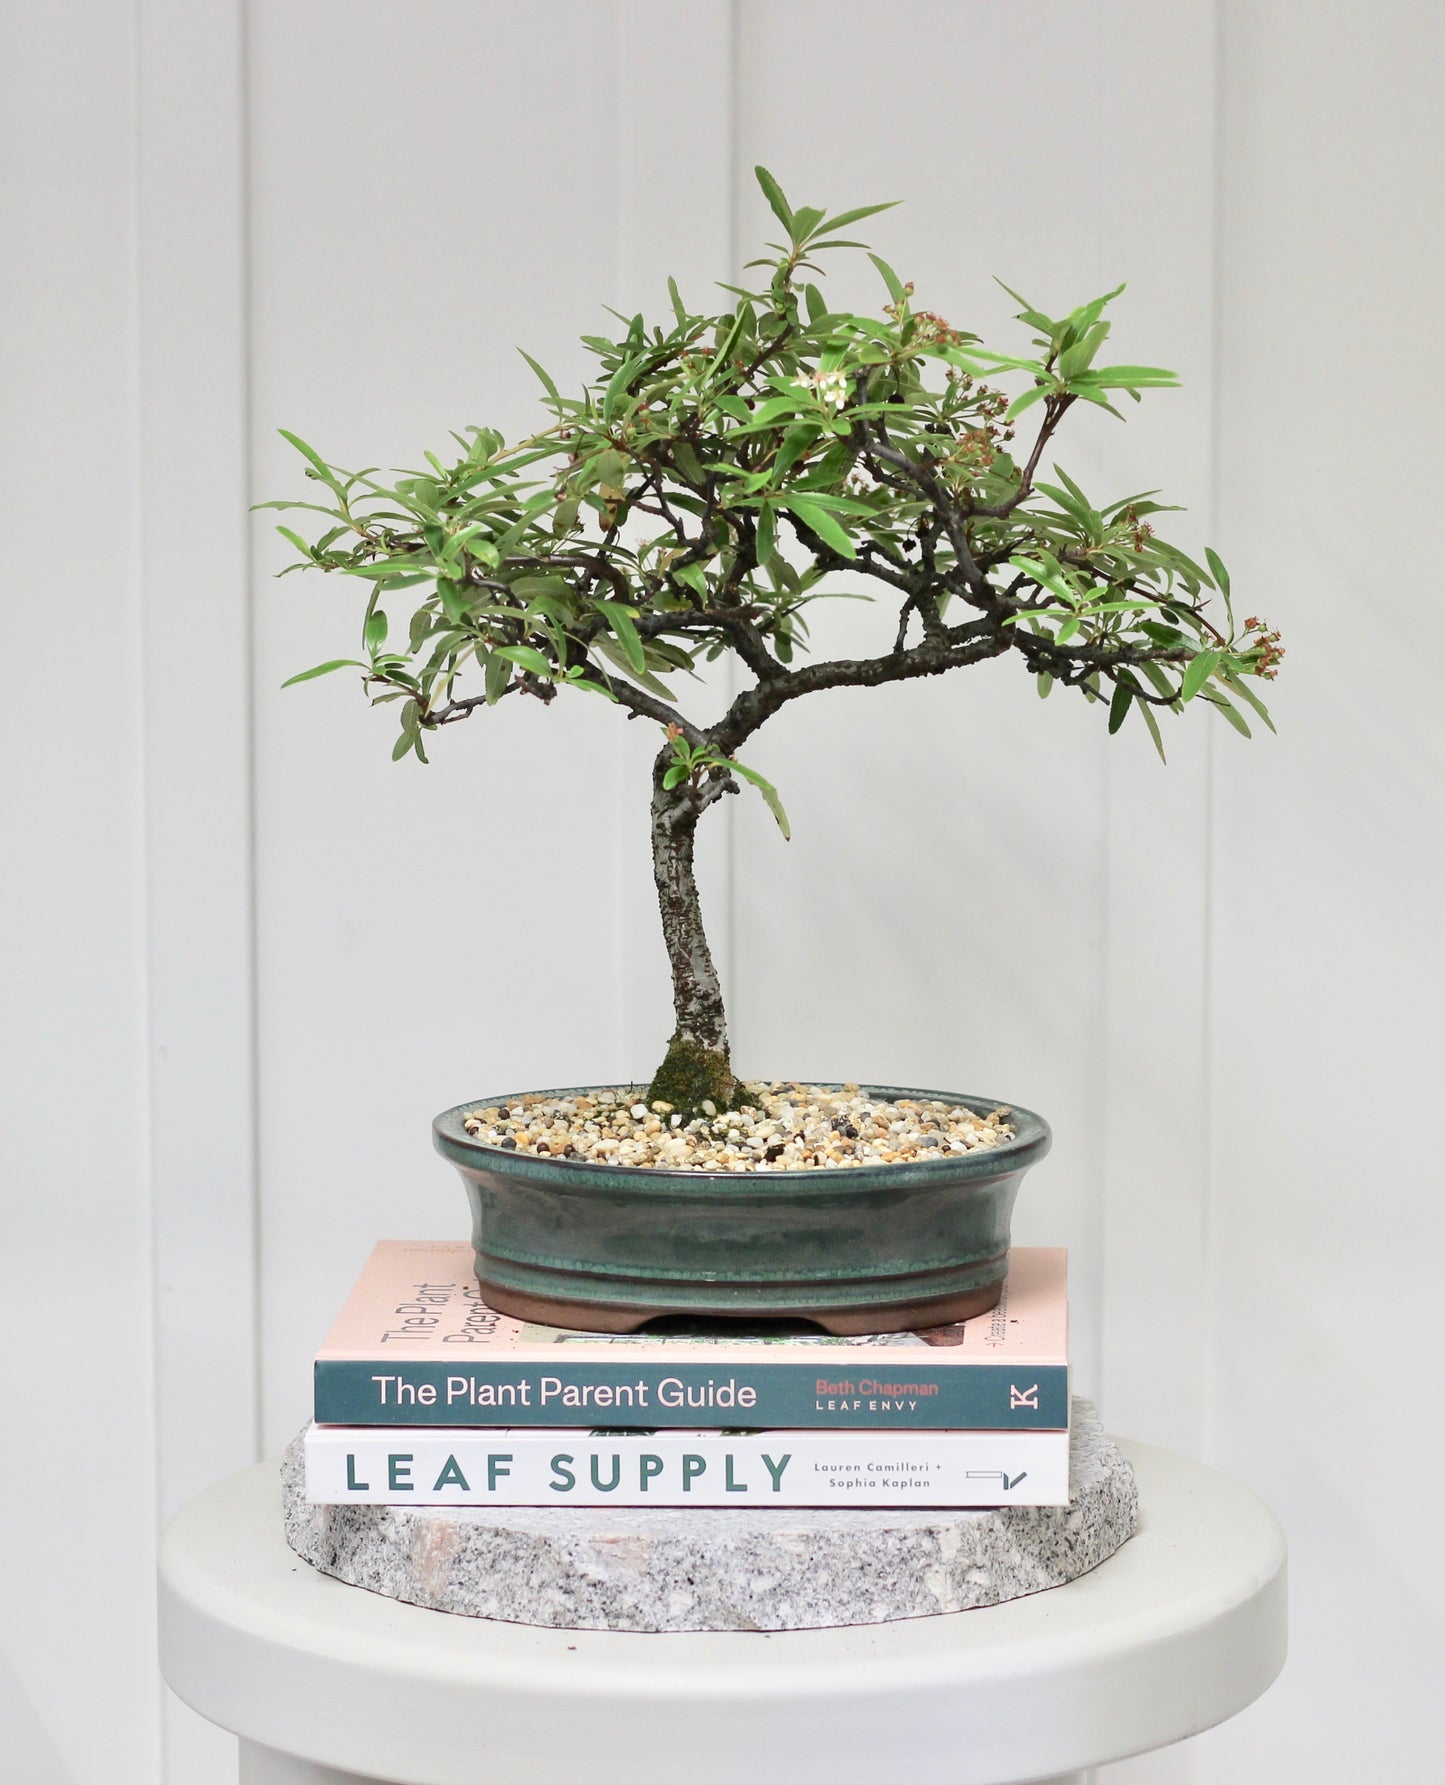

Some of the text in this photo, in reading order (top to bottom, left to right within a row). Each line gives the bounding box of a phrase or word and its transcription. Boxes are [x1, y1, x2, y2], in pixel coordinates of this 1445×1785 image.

[394, 1283, 457, 1315] Plant
[380, 1317, 440, 1343] The
[441, 1303, 502, 1344] Parent
[371, 1375, 757, 1408] The Plant Parent Guide
[815, 1379, 938, 1398] Beth Chapman
[815, 1400, 917, 1411] LEAF ENVY
[346, 1453, 792, 1492] LEAF SUPPLY
[814, 1462, 861, 1472] Lauren
[866, 1462, 929, 1472] Camilleri
[829, 1478, 931, 1489] Sophia Kaplan
